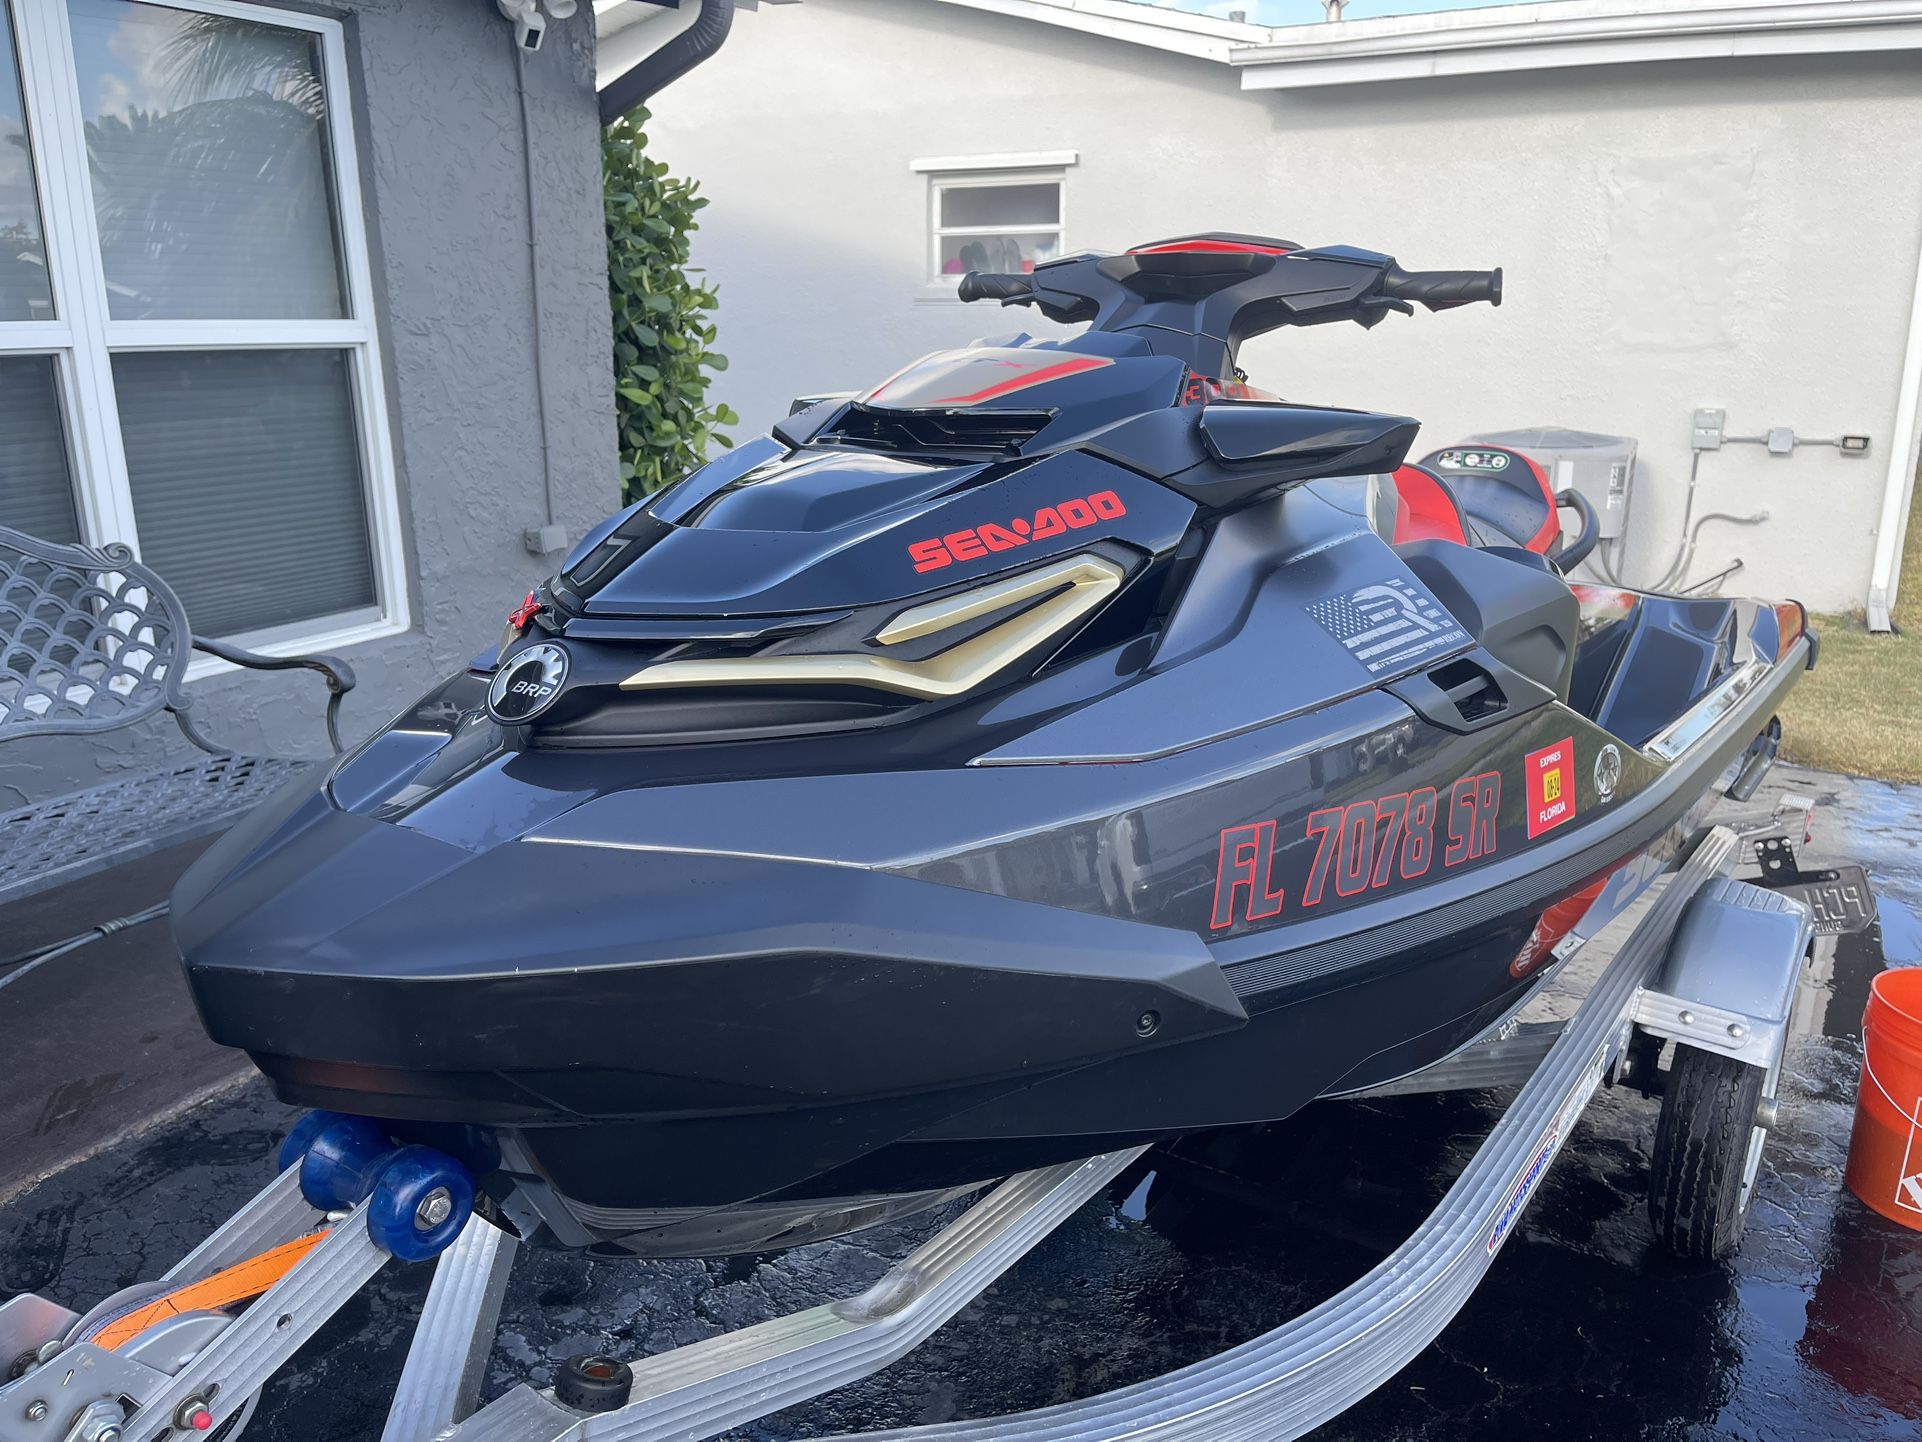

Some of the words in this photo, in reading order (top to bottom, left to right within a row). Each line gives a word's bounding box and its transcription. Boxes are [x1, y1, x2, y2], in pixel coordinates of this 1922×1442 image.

[511, 681, 552, 698] BRP
[1539, 750, 1562, 768] EXPIRES
[1539, 800, 1566, 824] FLORIDA
[1210, 819, 1284, 929] FL
[1302, 786, 1438, 907] 7078
[1445, 770, 1501, 867] SR
